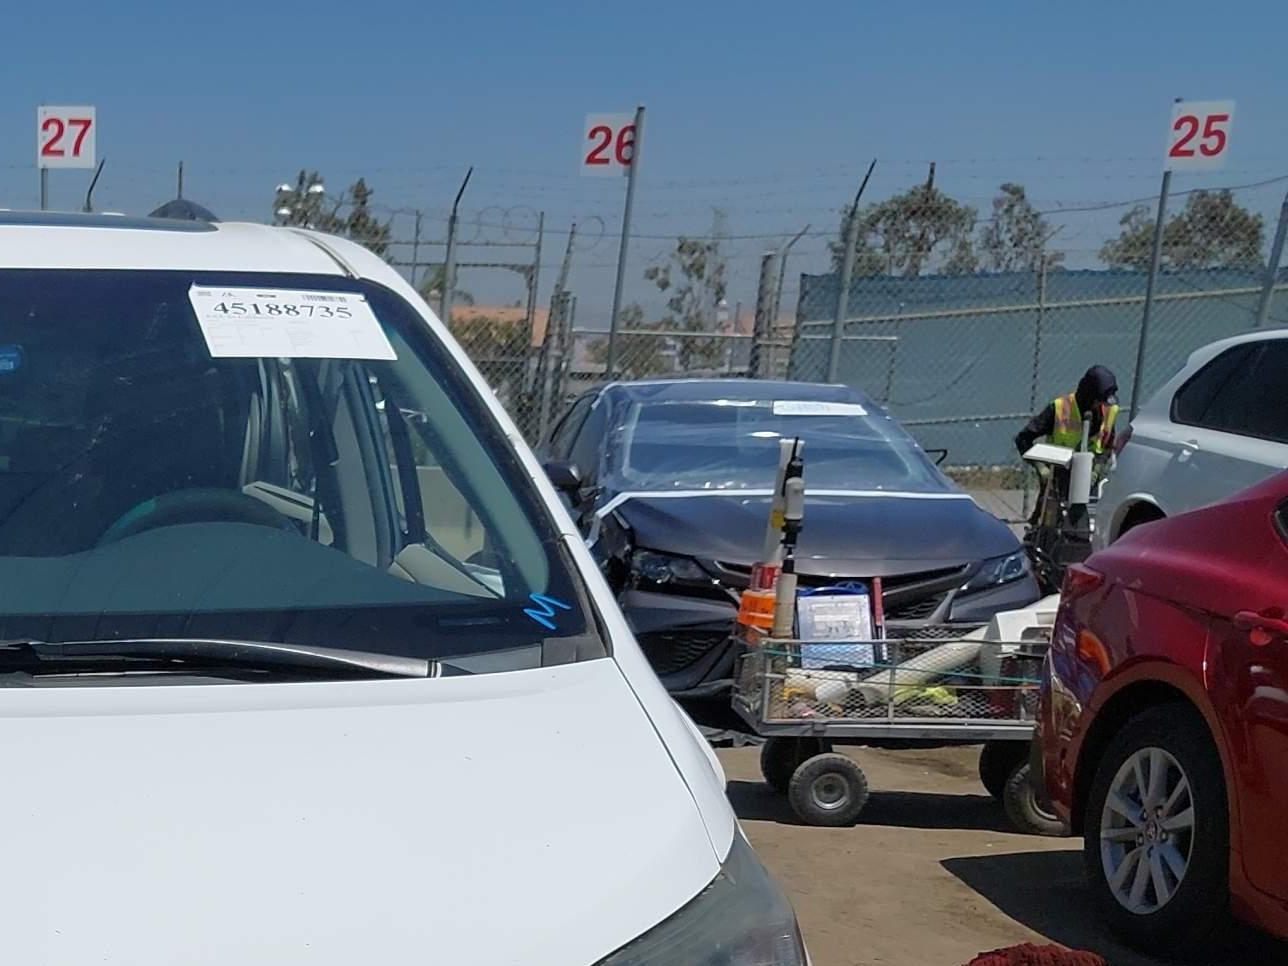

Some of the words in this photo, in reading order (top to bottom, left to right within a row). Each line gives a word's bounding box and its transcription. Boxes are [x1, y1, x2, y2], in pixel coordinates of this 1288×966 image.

[41, 117, 92, 158] 27
[585, 125, 635, 165] 26
[1169, 114, 1229, 157] 25
[214, 302, 353, 319] 45188735
